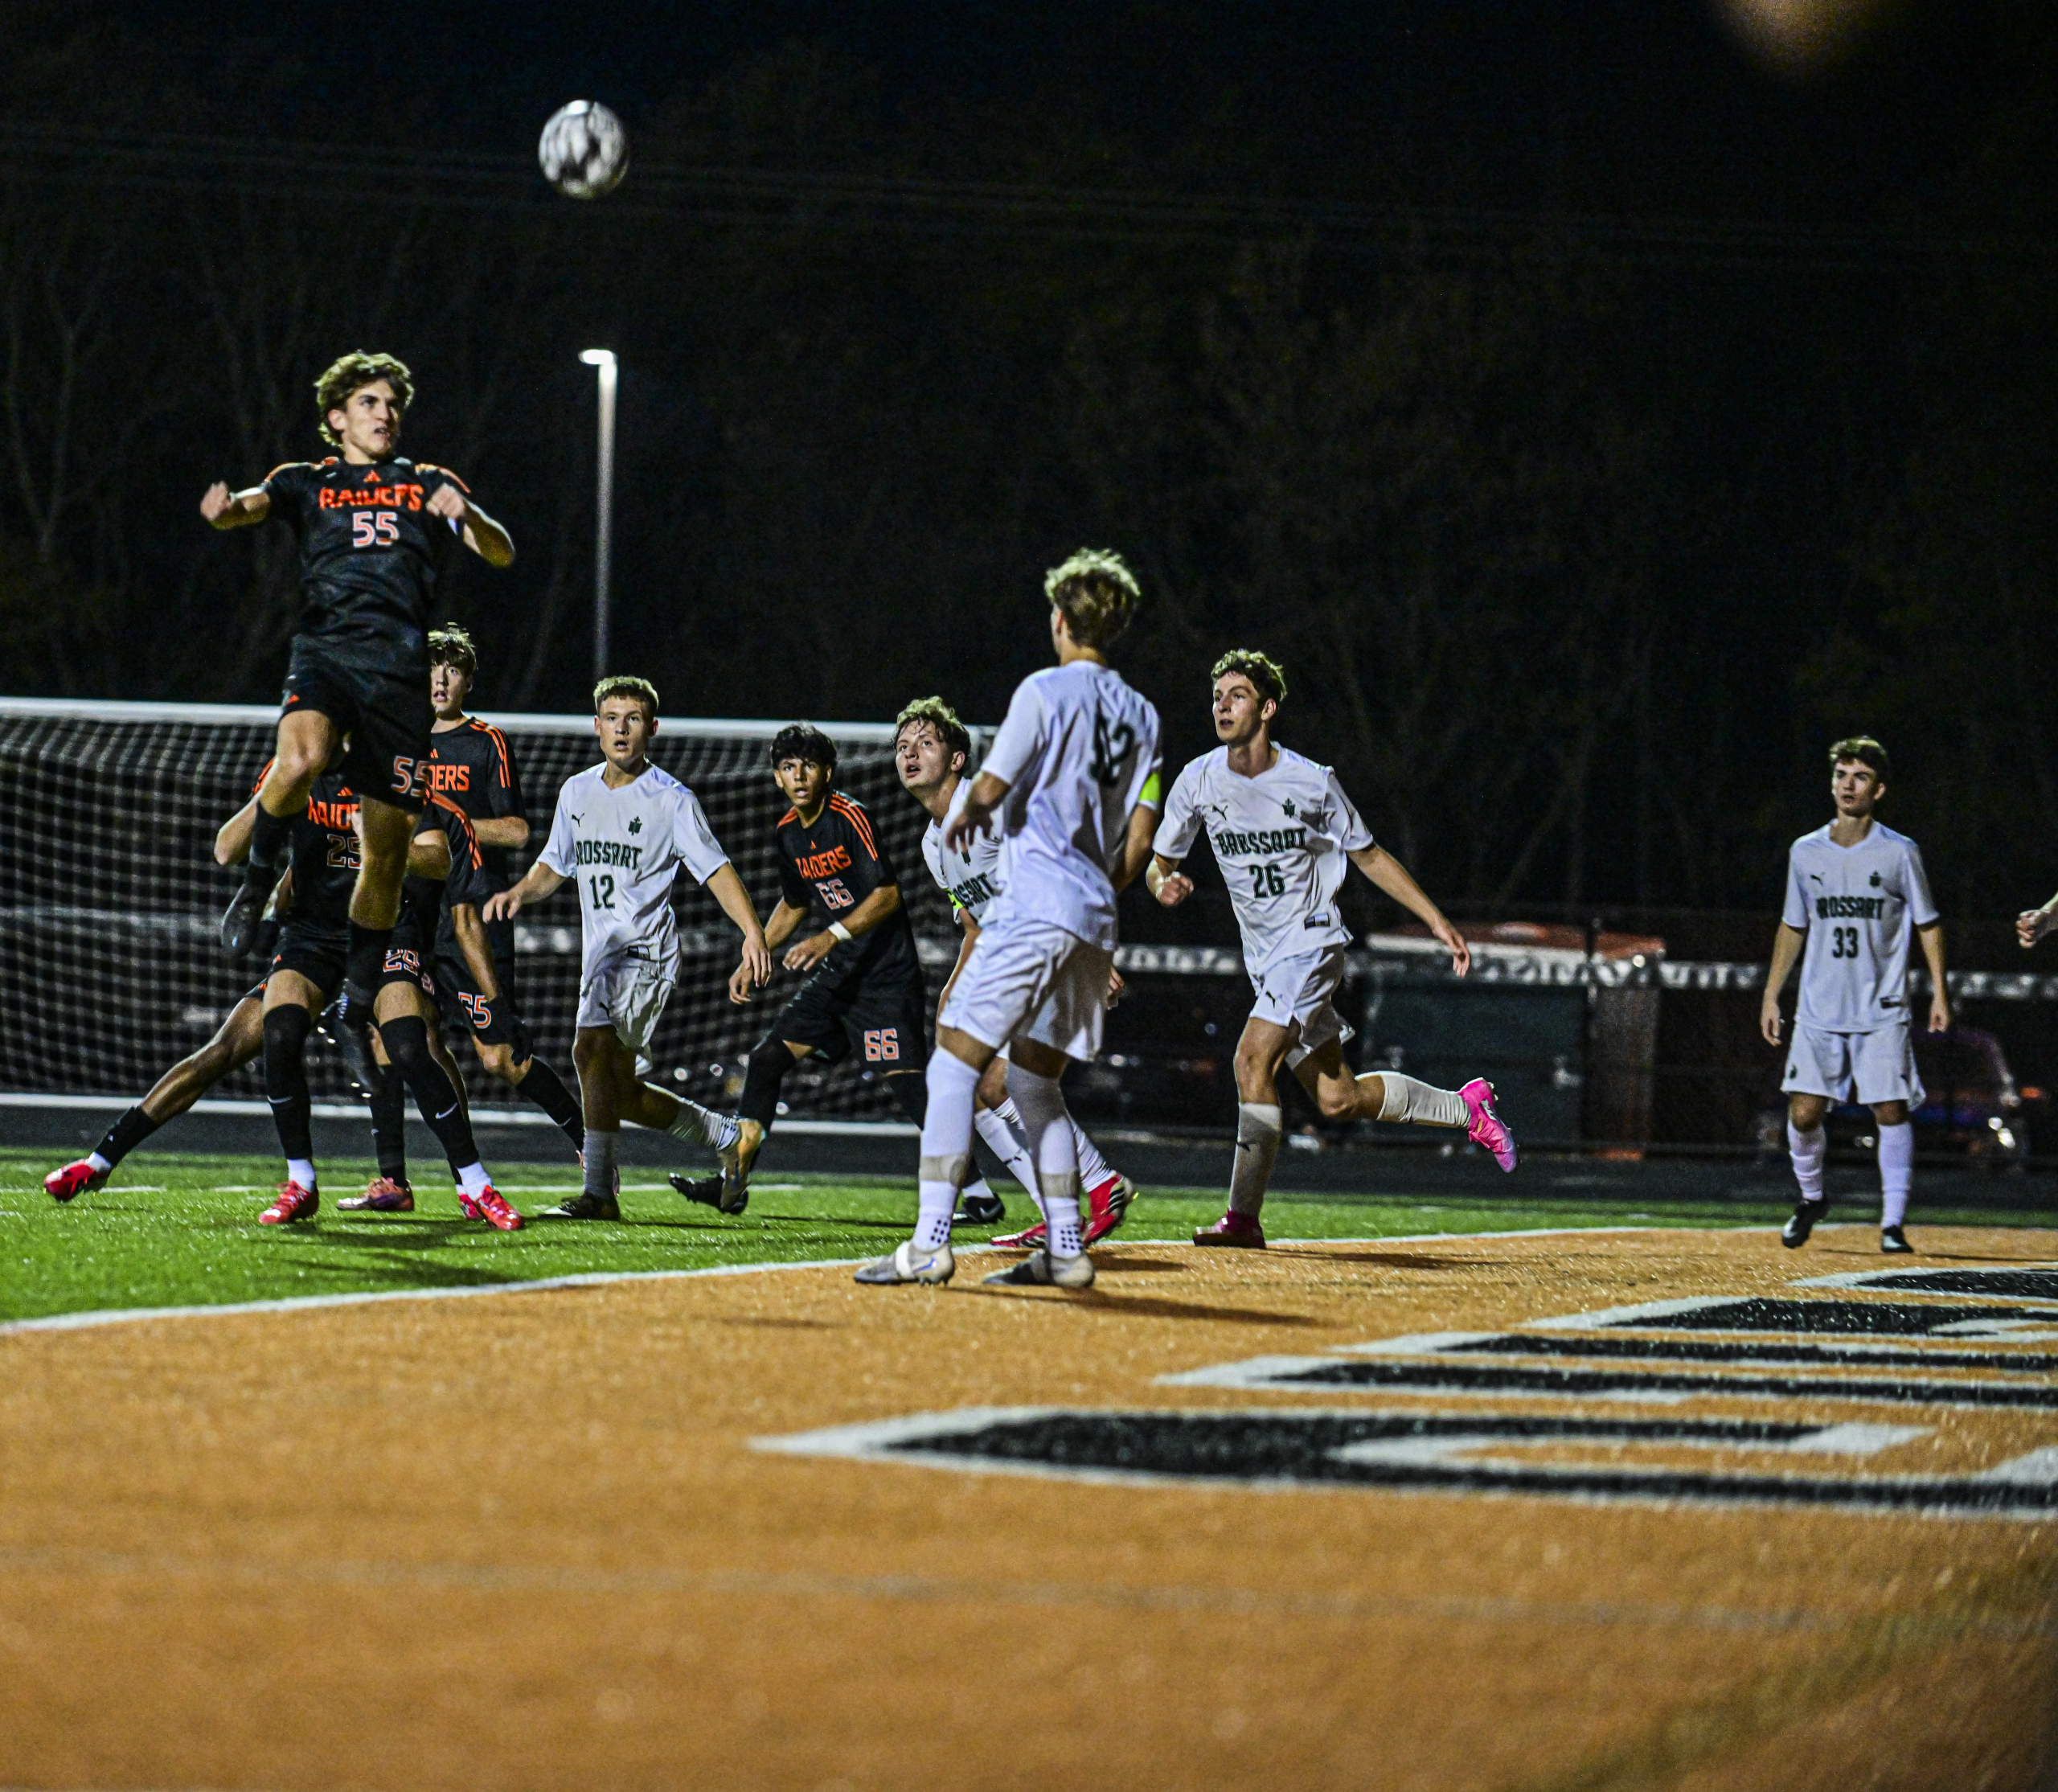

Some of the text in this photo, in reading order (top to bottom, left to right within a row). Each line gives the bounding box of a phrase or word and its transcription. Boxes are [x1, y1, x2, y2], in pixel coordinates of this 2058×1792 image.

[352, 511, 400, 548] 55
[589, 874, 615, 910] 12
[815, 877, 855, 910] 66
[1248, 863, 1285, 899] 26
[1832, 926, 1859, 958] 33
[863, 1027, 900, 1061] 66
